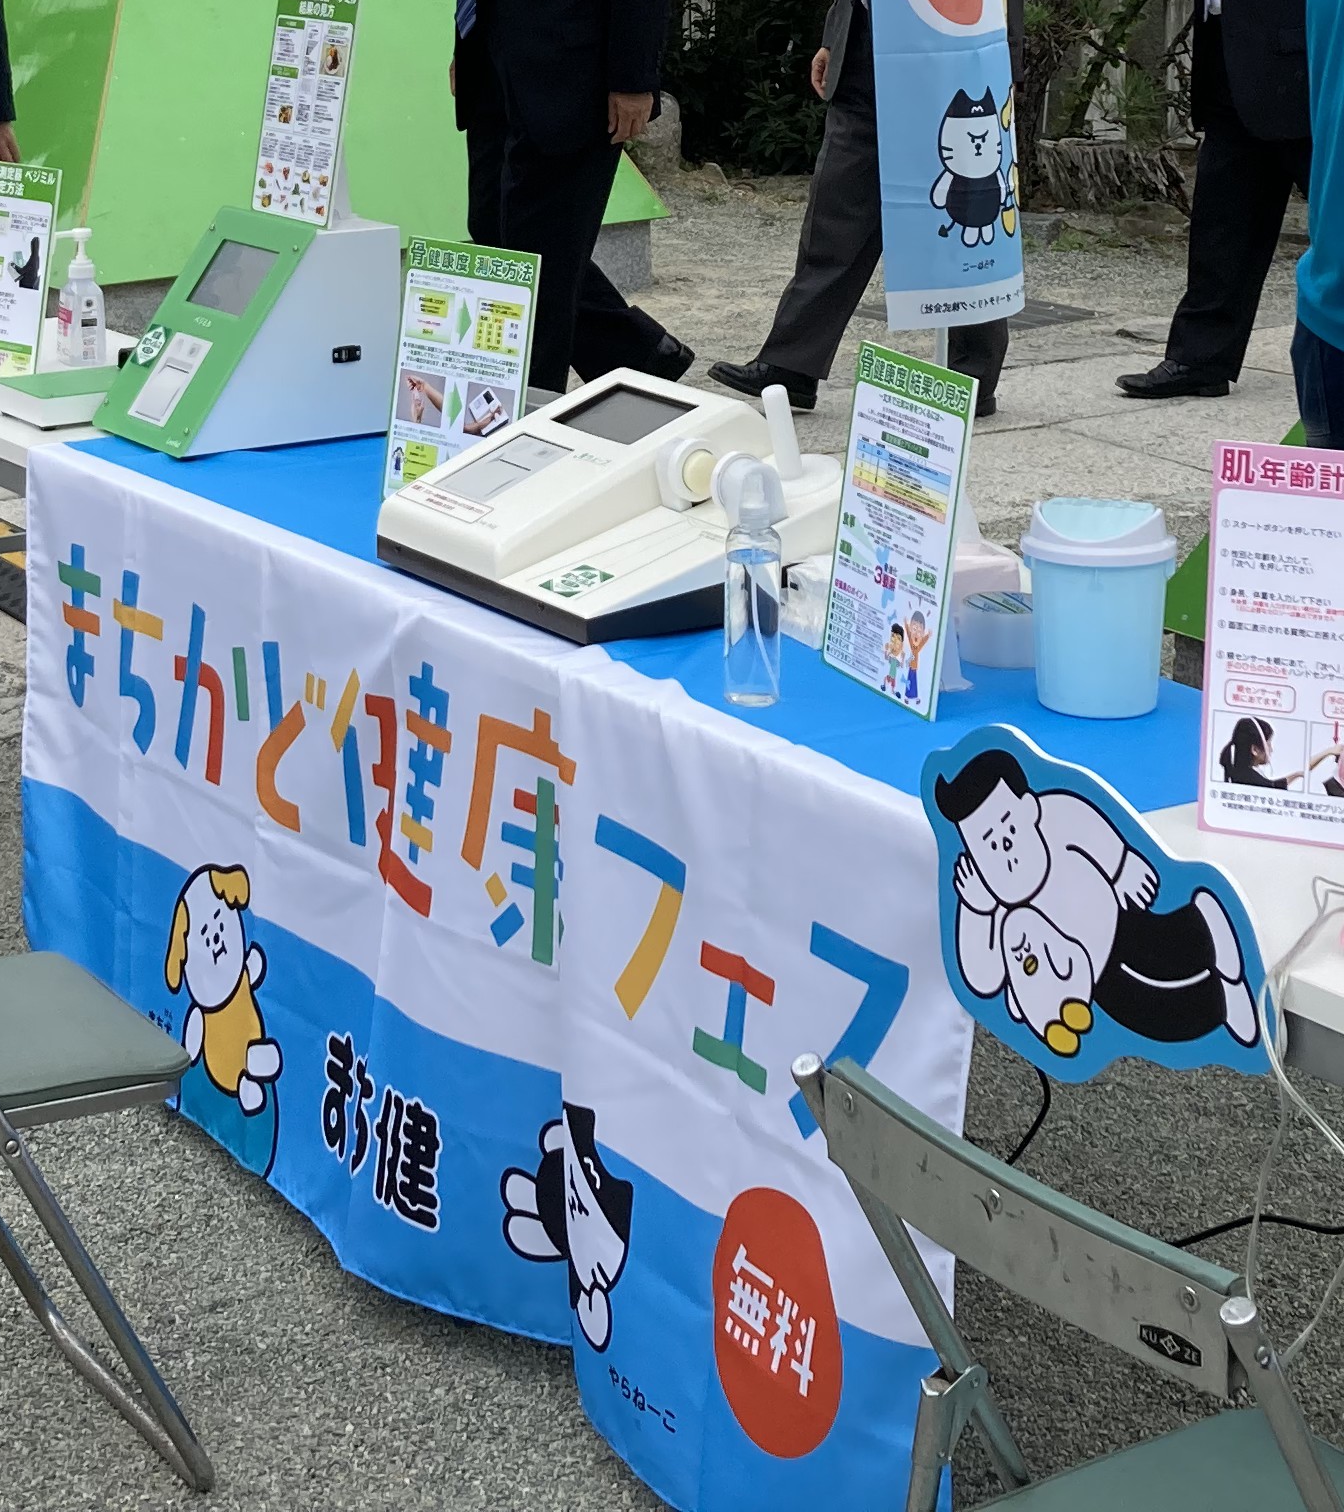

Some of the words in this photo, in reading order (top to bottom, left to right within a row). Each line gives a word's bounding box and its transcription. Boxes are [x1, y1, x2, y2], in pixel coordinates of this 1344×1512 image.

[299, 1, 336, 18] 結果の見方
[24, 170, 57, 186] ベジミル
[409, 241, 470, 274] 骨健康度
[474, 254, 534, 285] 測定方法
[859, 347, 909, 392] 骨健康度
[909, 370, 970, 414] 結果の見方
[58, 543, 910, 1140] まちかど健康フェス
[723, 1244, 817, 1398] 無料
[609, 1364, 676, 1434] やらねーこ
